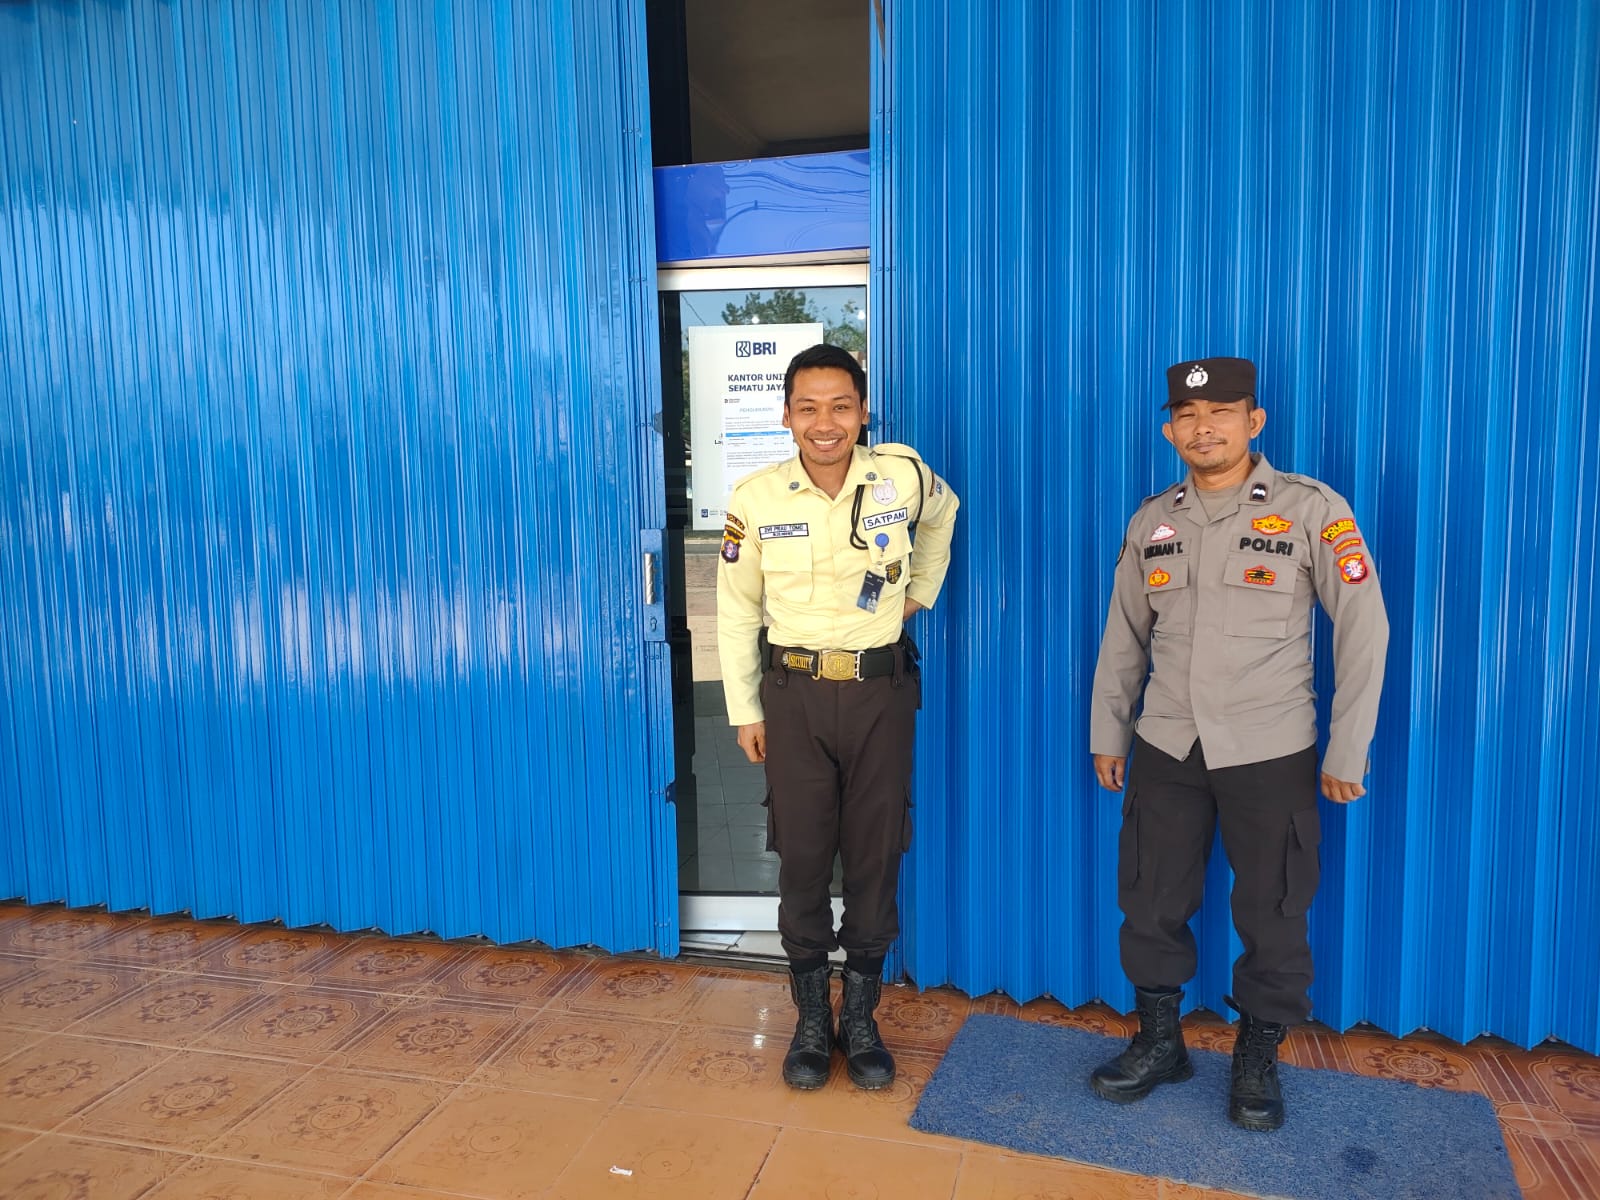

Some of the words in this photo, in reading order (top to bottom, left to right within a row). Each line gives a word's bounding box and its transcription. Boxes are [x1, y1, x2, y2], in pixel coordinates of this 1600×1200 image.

[752, 341, 777, 355] BRI
[727, 373, 764, 382] KANTOR
[728, 384, 764, 392] SEMATU
[867, 511, 905, 527] SATPAM
[1176, 541, 1184, 554] T.
[1239, 537, 1294, 556] POLRI
